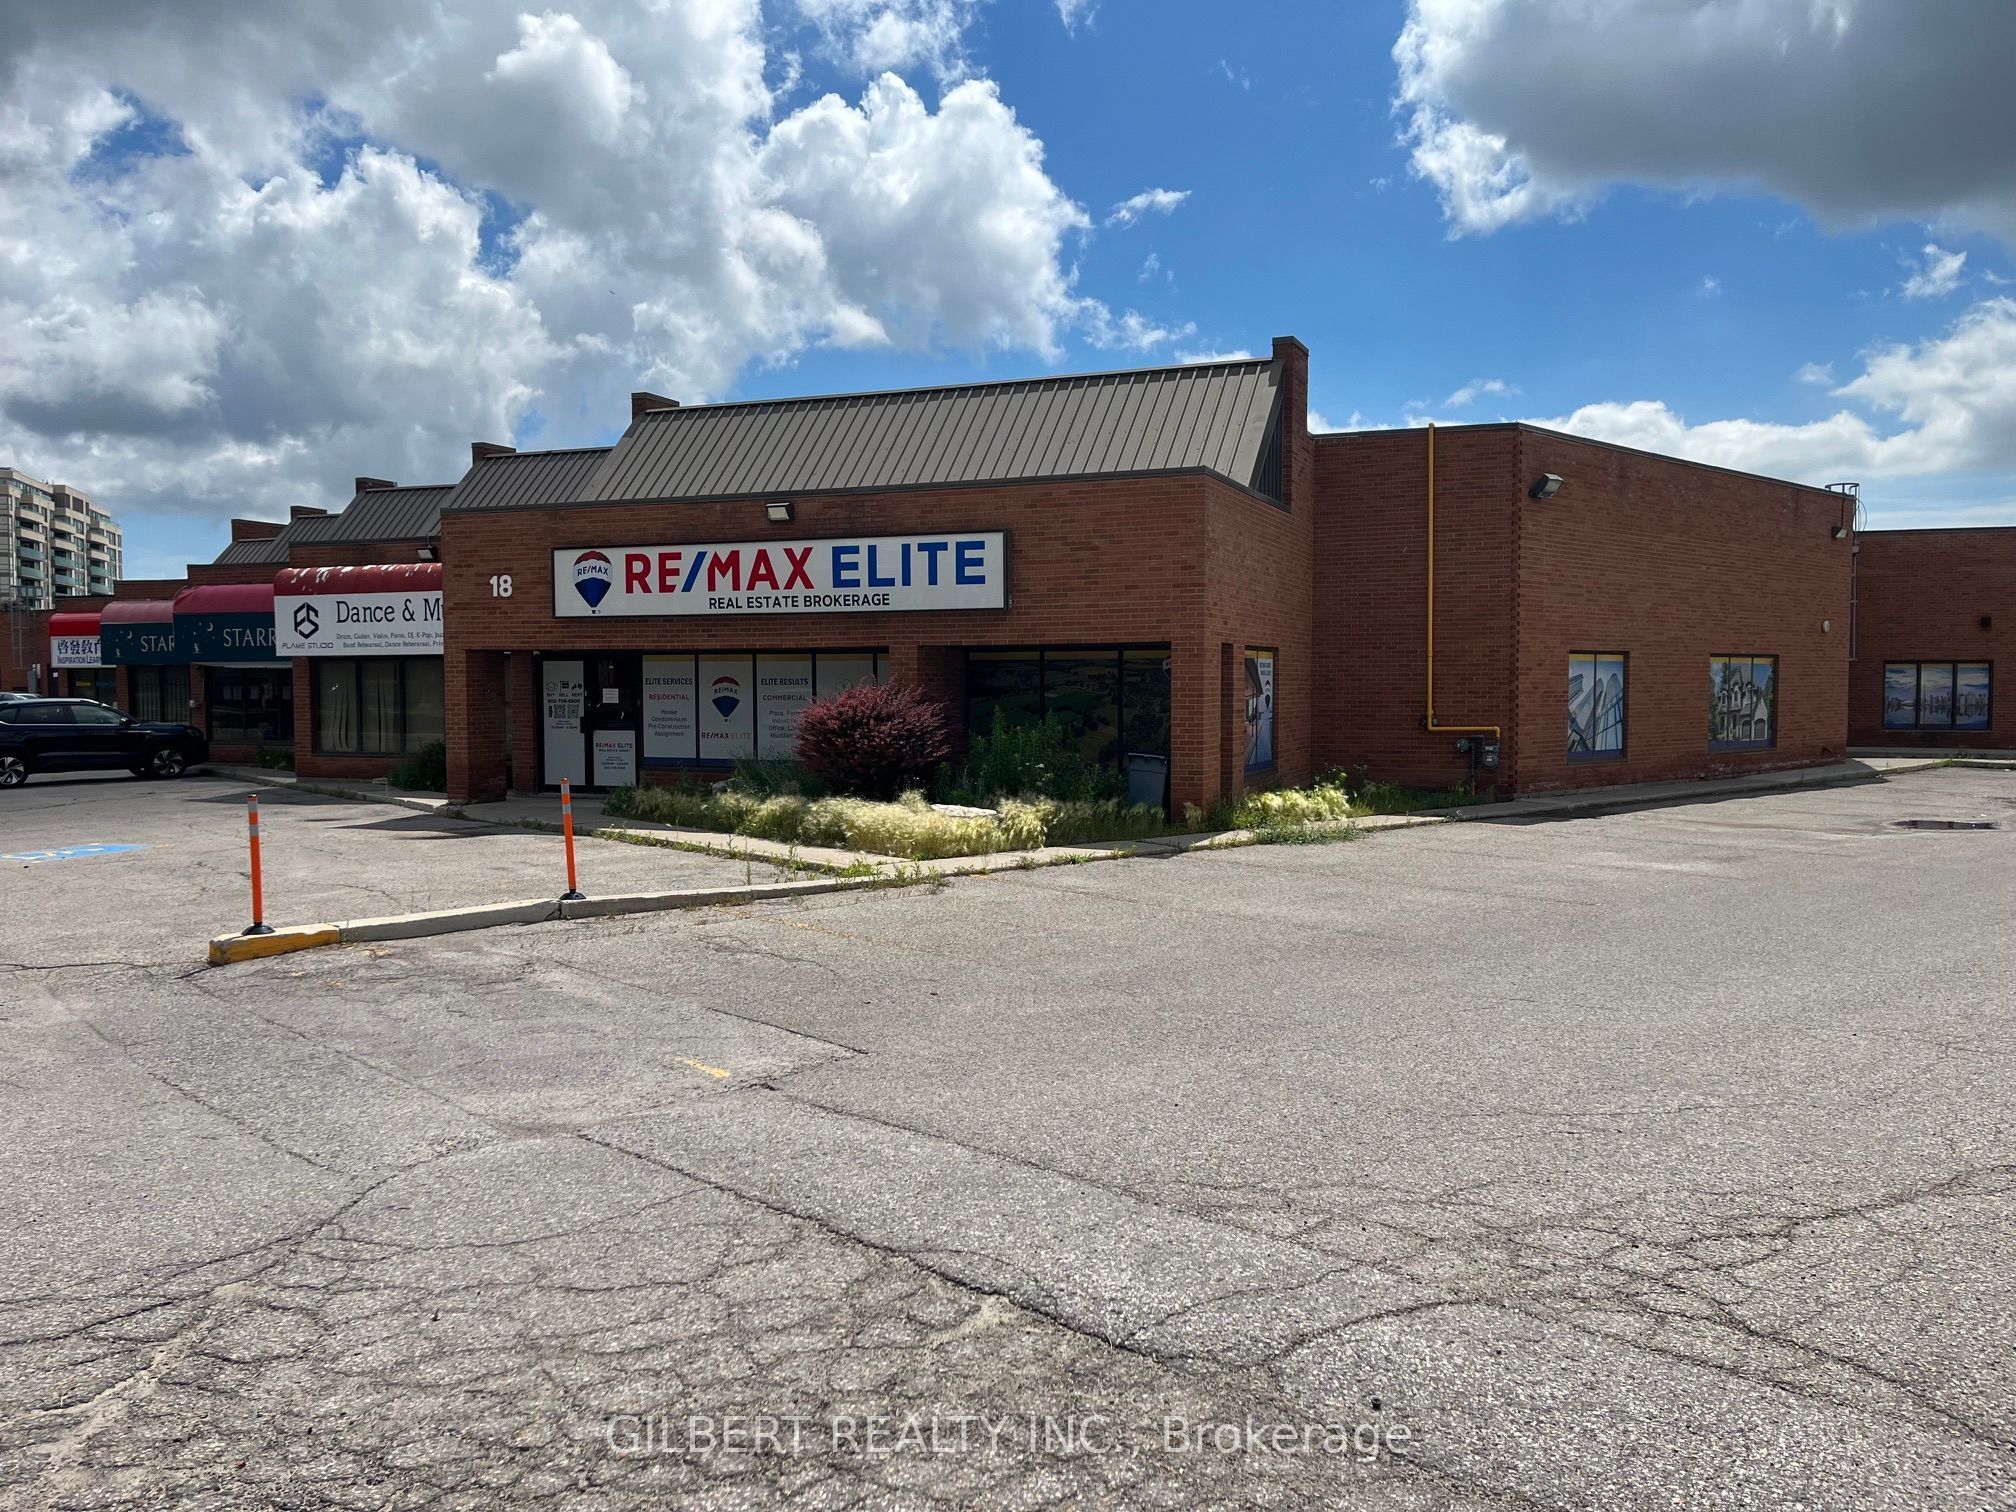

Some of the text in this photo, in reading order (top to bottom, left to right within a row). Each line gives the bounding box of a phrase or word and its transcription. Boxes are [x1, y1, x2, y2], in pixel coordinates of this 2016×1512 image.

[577, 565, 609, 577] RE/MAX
[625, 540, 986, 594] RE/MAX ELITE
[489, 574, 513, 598] 18
[709, 593, 891, 610] REAL ESTATE BROKERAGE
[336, 598, 443, 624] Dance & M
[645, 677, 693, 686] ELITE SERVICES
[761, 677, 809, 686] ELITE RESULTS
[713, 687, 738, 695] RE/MAX
